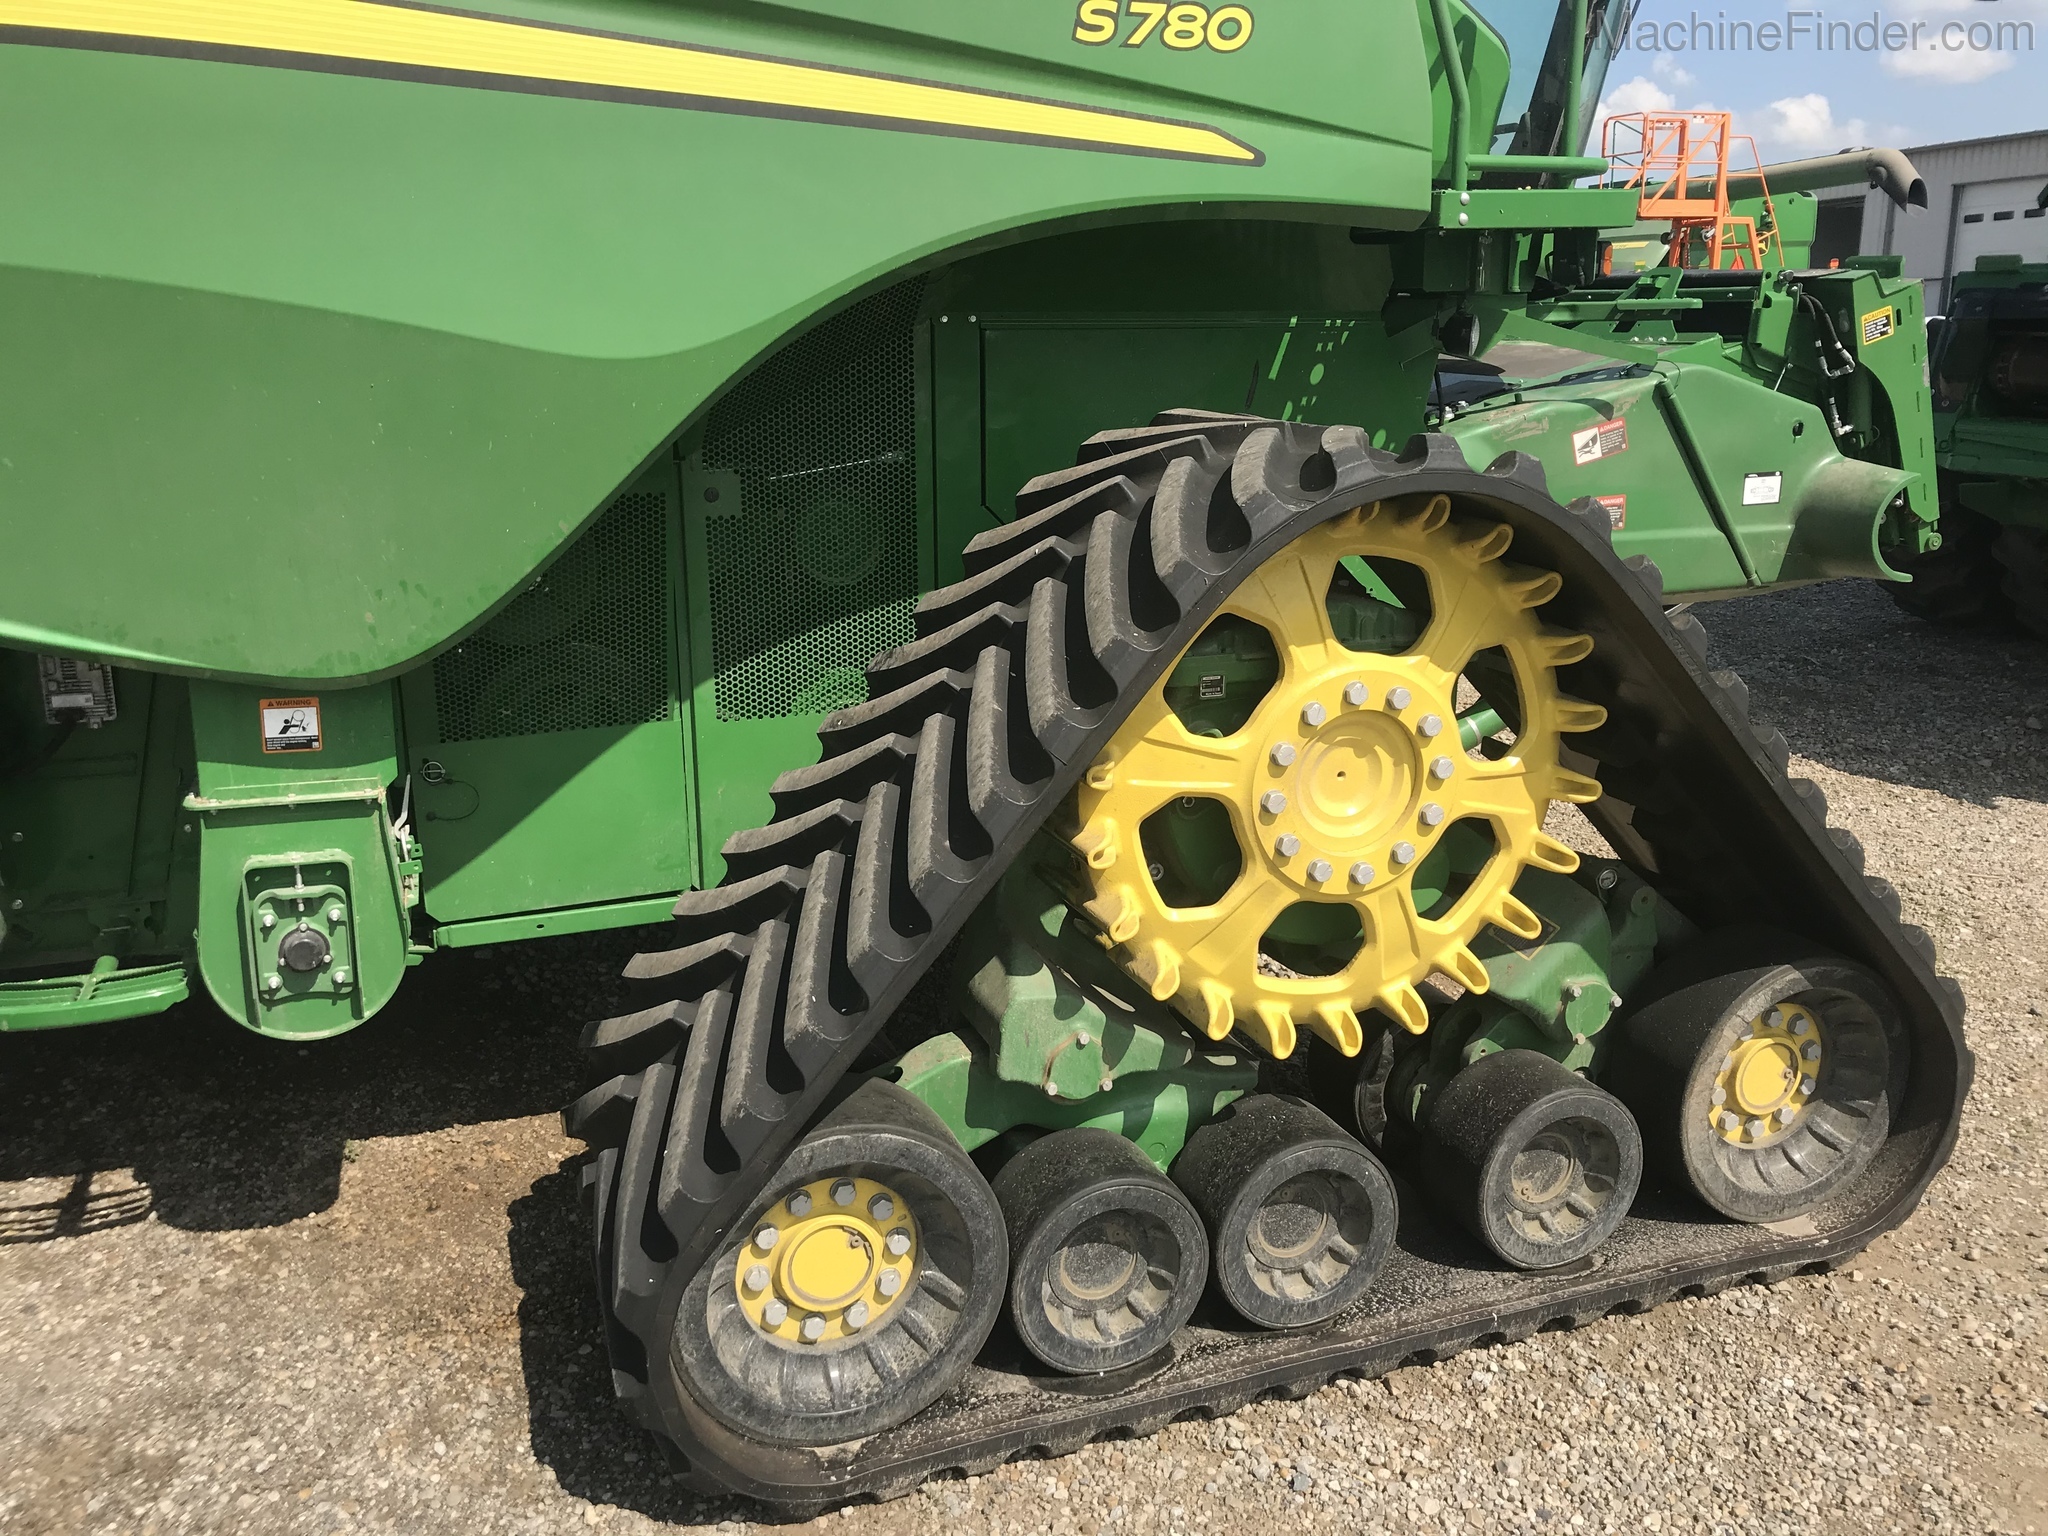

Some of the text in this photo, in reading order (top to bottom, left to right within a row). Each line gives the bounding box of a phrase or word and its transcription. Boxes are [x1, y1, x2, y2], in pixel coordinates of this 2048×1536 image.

[1072, 0, 1255, 54] S780
[1867, 307, 1891, 321] CAUTION
[1603, 420, 1623, 431] DANGER
[1603, 497, 1624, 505] DANGER
